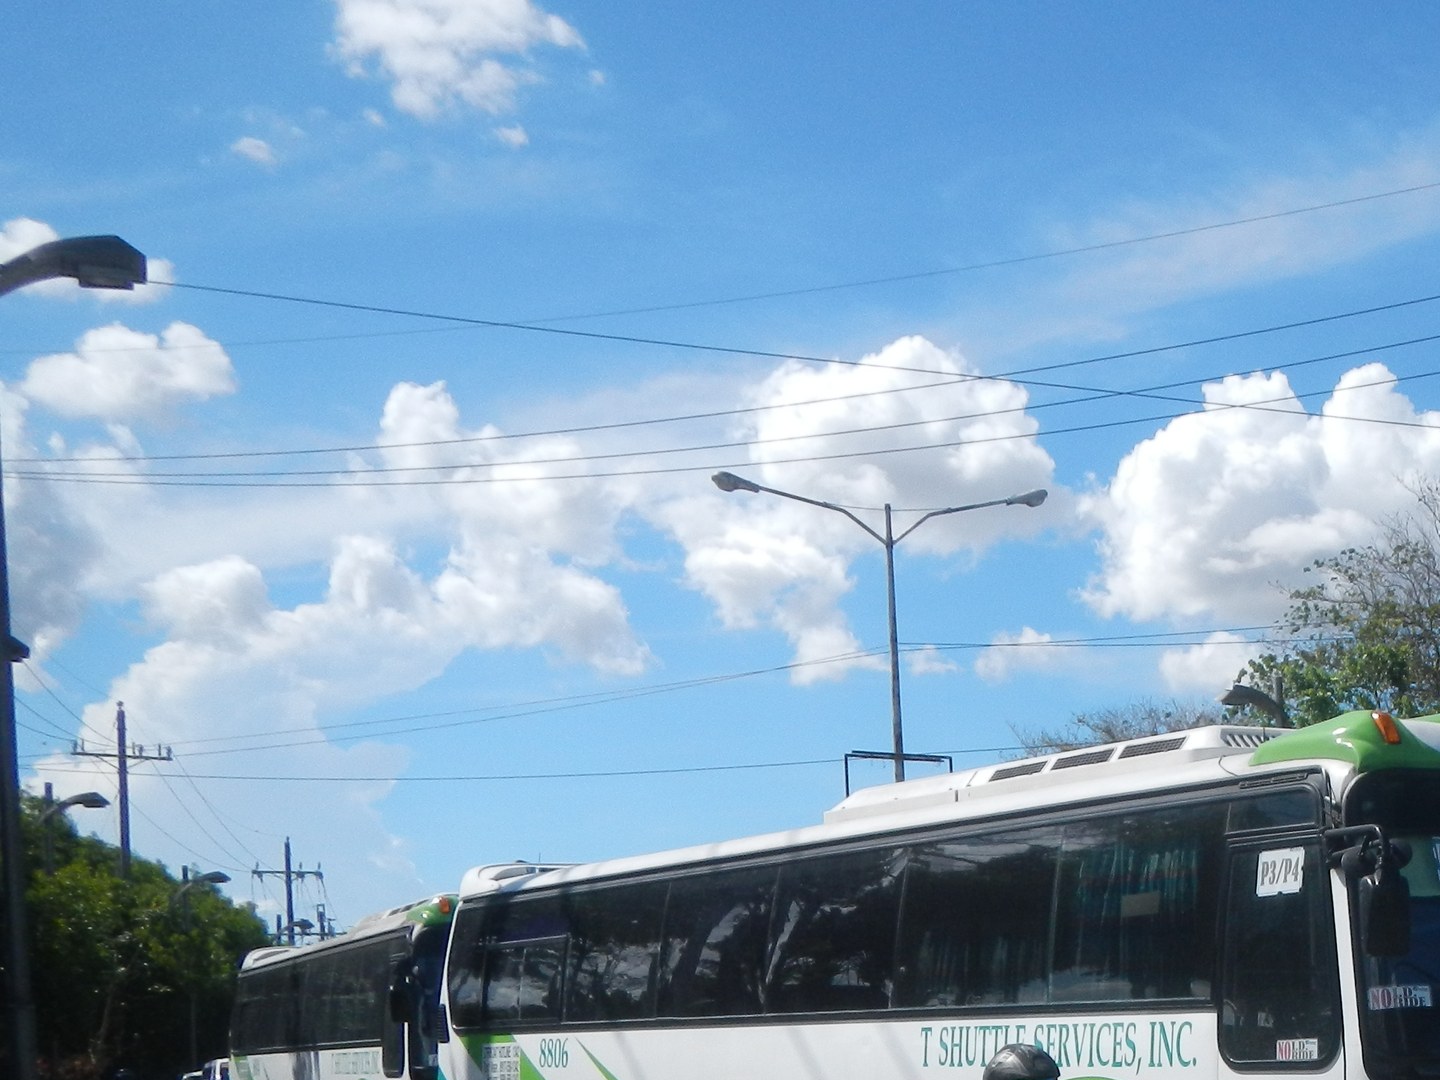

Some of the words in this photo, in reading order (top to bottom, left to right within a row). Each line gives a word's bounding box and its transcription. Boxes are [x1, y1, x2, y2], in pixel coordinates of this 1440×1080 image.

[1260, 857, 1300, 886] P3/P4
[539, 1038, 569, 1068] 8806
[921, 1027, 933, 1067] T
[1033, 1022, 1142, 1075] SERVICES,
[1148, 1021, 1197, 1067] INC.
[1278, 1040, 1292, 1060] NO
